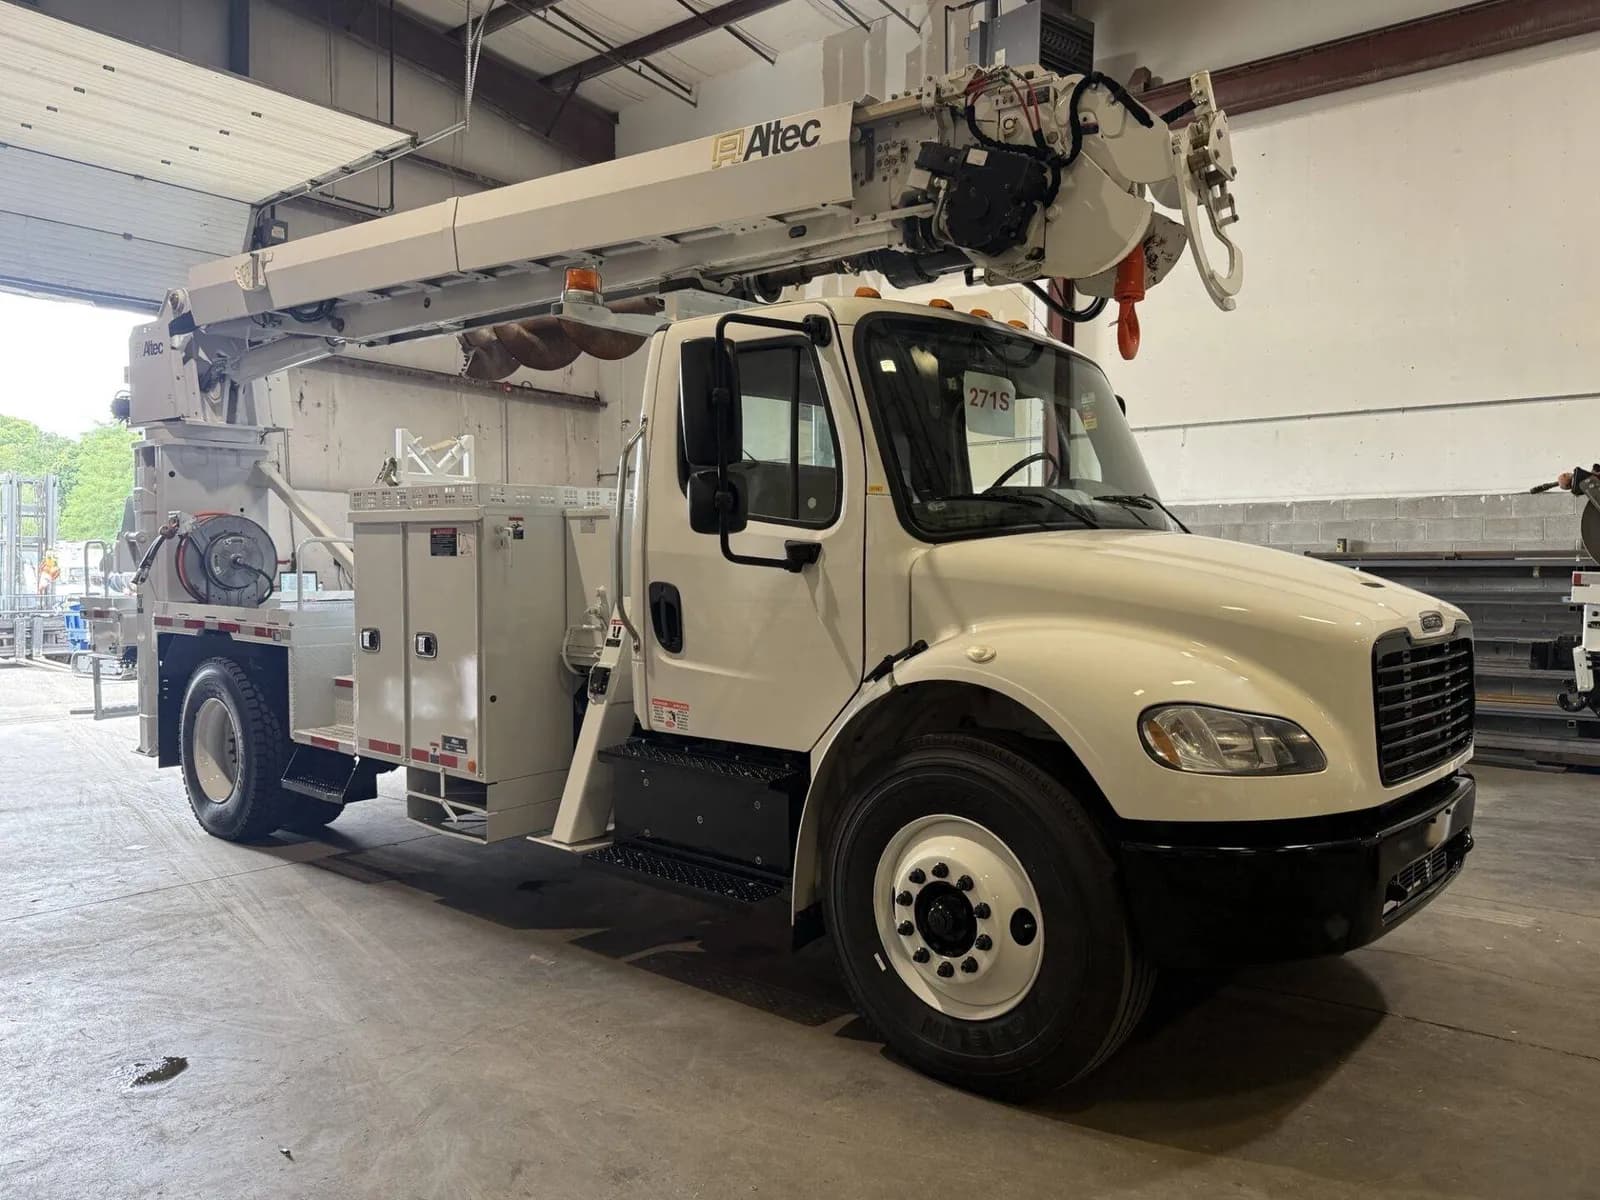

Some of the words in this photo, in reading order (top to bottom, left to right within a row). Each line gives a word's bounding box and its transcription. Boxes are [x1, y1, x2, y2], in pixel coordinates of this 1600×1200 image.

[742, 119, 821, 162] Altec
[143, 340, 164, 357] Altec
[969, 387, 1010, 411] 271S
